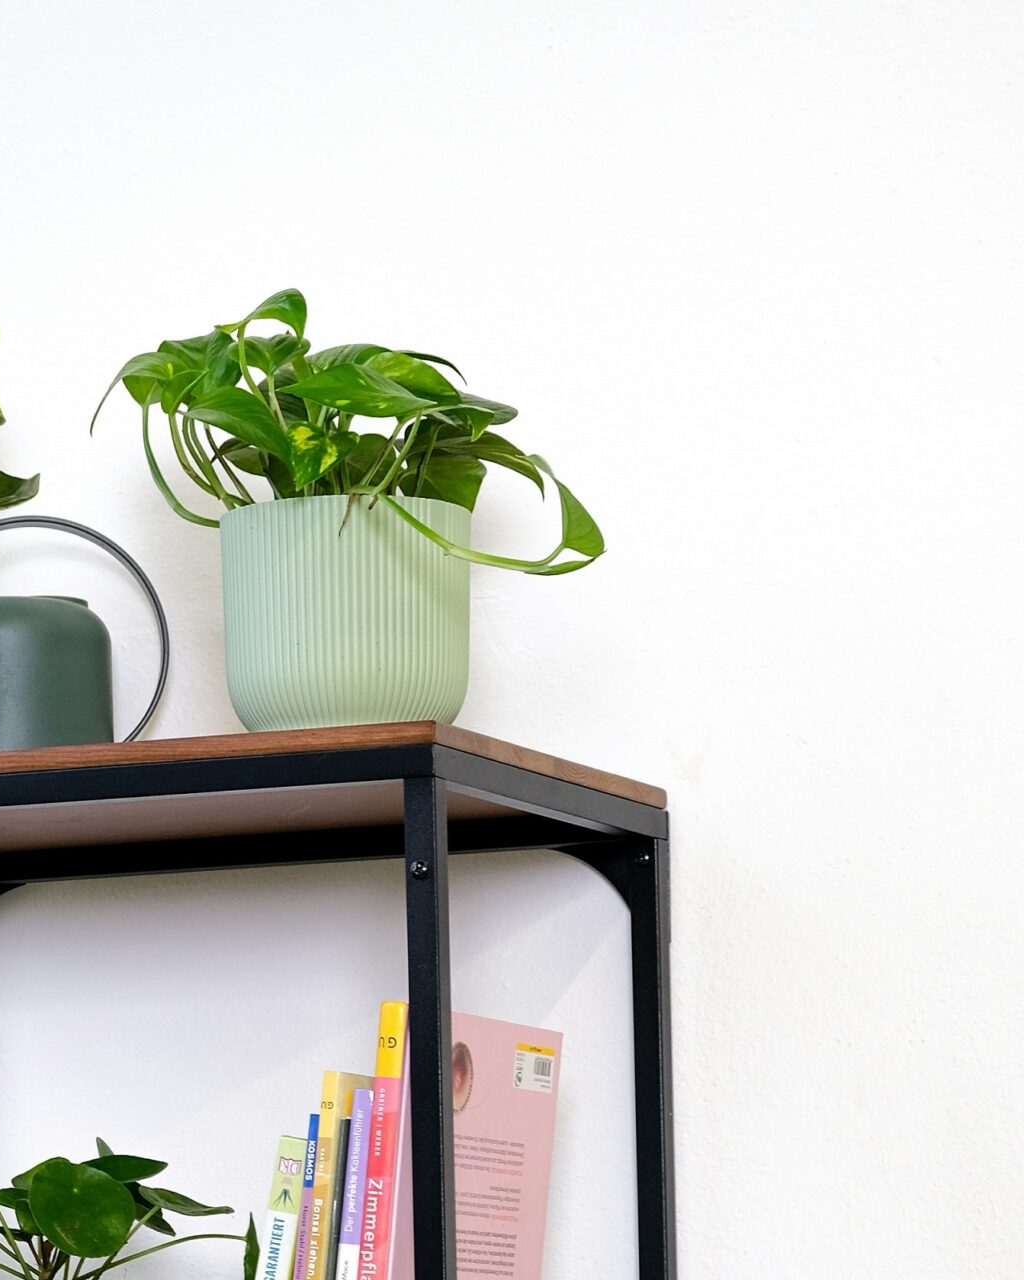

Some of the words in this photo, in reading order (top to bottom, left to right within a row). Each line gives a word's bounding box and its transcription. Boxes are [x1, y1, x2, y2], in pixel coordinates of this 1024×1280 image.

[305, 1140, 316, 1181] KOSMOS
[350, 1109, 364, 1173] Kakteenführer
[374, 1129, 384, 1156] WEBER
[347, 1174, 359, 1213] perfekte
[311, 1198, 323, 1237] Bonsai
[344, 1215, 355, 1232] Der
[306, 1240, 318, 1280] ziehen,
